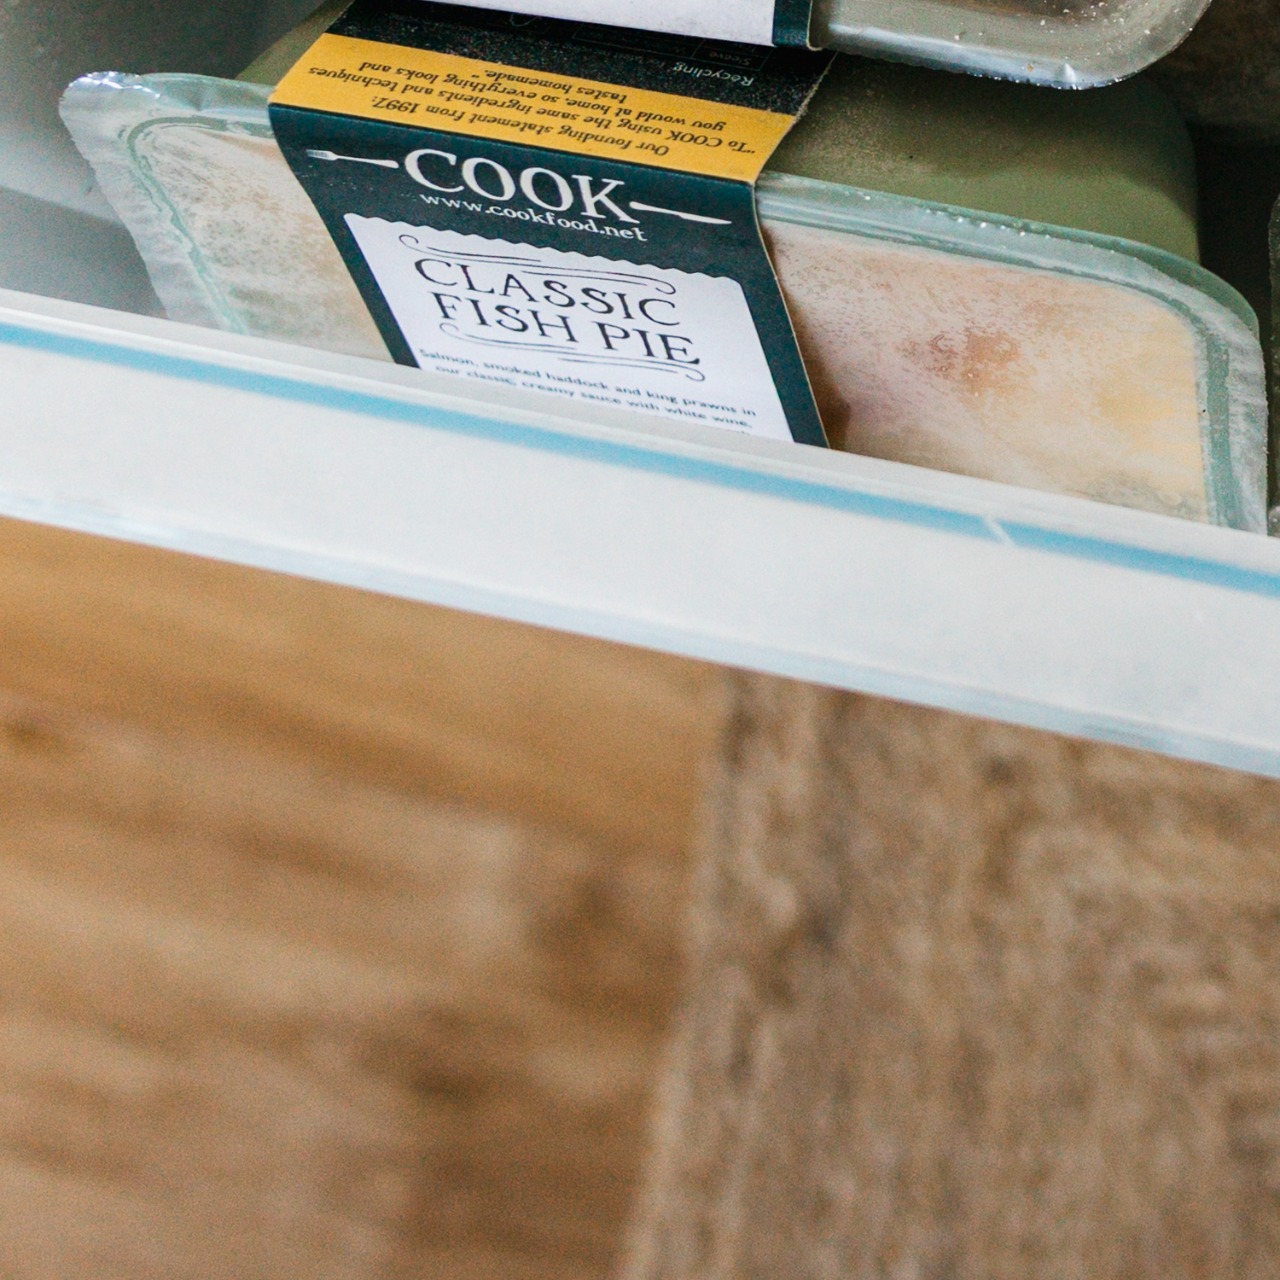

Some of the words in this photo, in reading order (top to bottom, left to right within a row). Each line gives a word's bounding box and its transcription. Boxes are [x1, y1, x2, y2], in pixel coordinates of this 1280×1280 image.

[358, 62, 391, 72] and
[674, 61, 754, 86] Recycling
[309, 67, 398, 92] techniques
[396, 68, 439, 84] looks
[401, 84, 434, 95] and
[443, 74, 537, 99] everything
[438, 91, 532, 114] ingredients
[577, 87, 627, 104] tastes
[372, 96, 420, 113] 1997:
[565, 98, 611, 115] home,
[615, 108, 632, 117] at
[426, 106, 466, 121] from
[536, 108, 580, 120] same
[635, 111, 685, 125] would
[469, 114, 553, 135] statement
[583, 116, 612, 129] the
[617, 119, 662, 135] using
[691, 121, 727, 131] you
[557, 125, 632, 150] founding
[665, 130, 723, 147] COOK
[636, 142, 669, 156] Our
[404, 147, 640, 223] COOK
[420, 193, 647, 242] www.cookfood.net
[414, 259, 681, 327] CLASSIC
[434, 292, 578, 343] FISH
[589, 321, 700, 366] PIE
